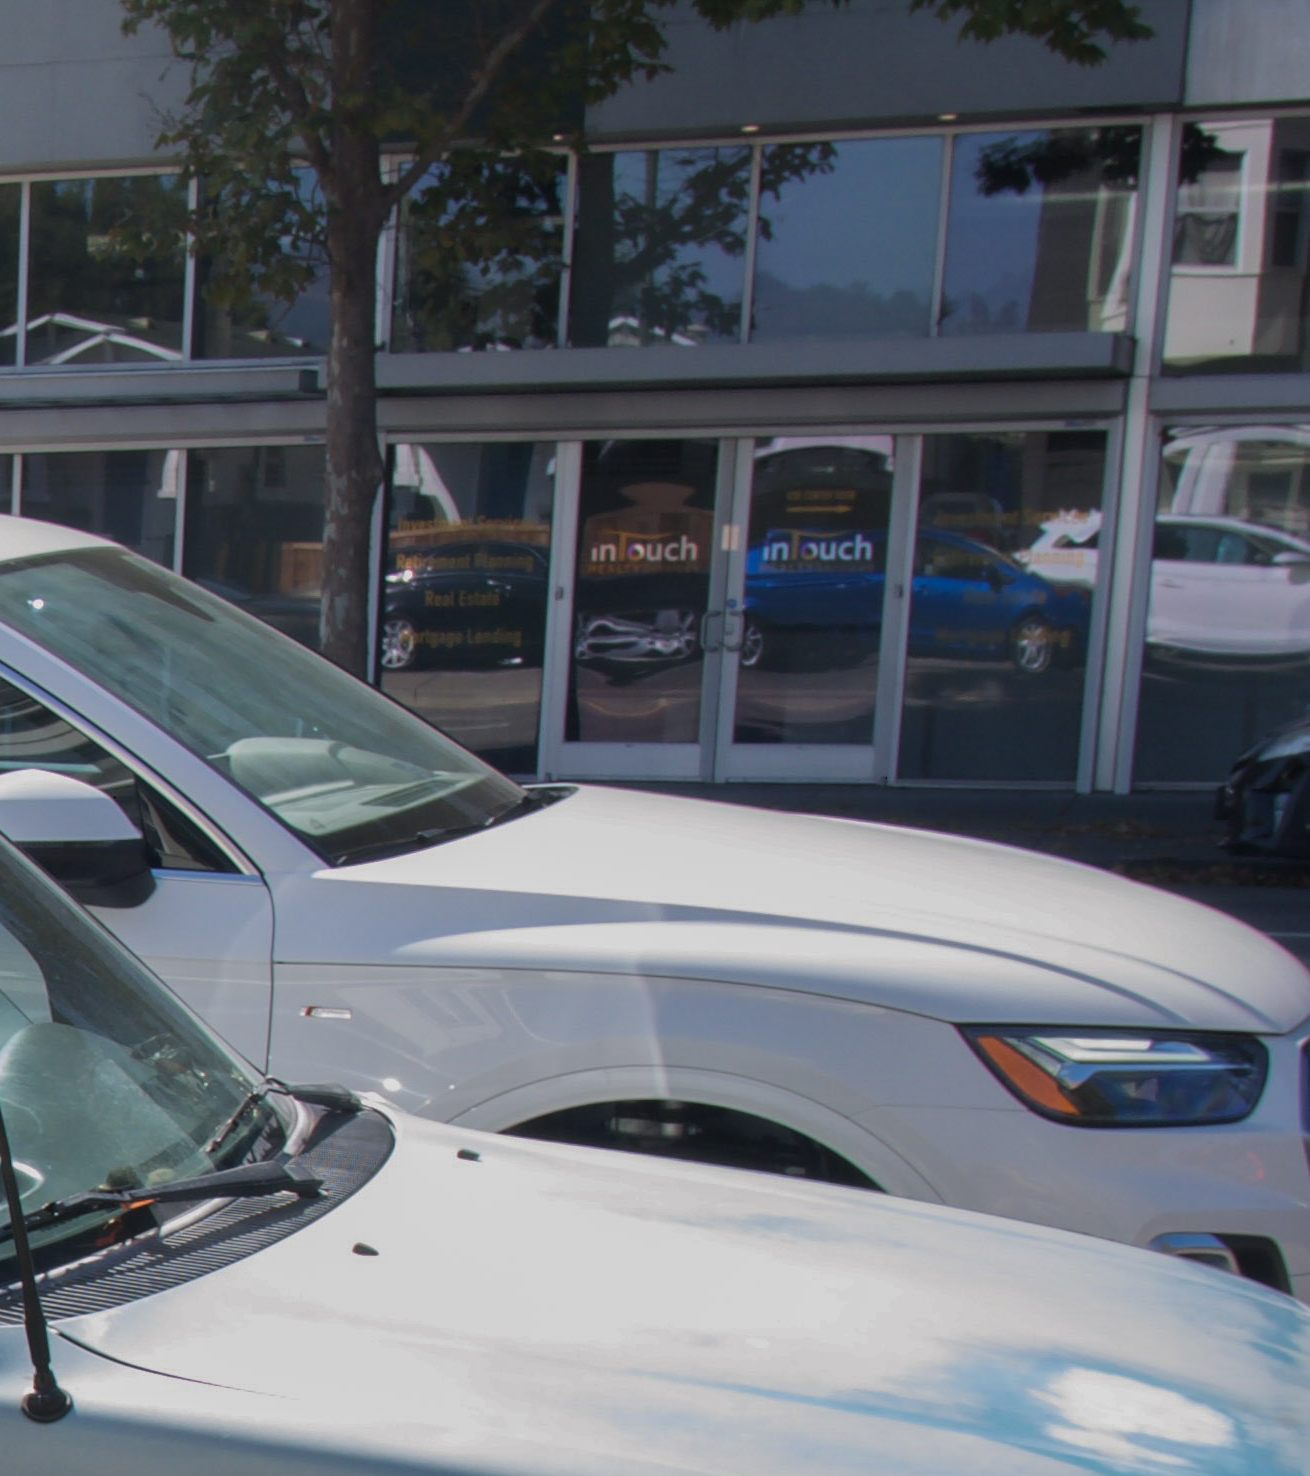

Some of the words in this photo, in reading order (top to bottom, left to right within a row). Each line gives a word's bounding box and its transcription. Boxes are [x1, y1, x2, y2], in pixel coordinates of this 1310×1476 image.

[590, 529, 699, 562] inTouch
[763, 528, 873, 562] inTouch
[424, 590, 455, 607] Real
[459, 590, 501, 607] Estate
[468, 627, 522, 648] Lending
